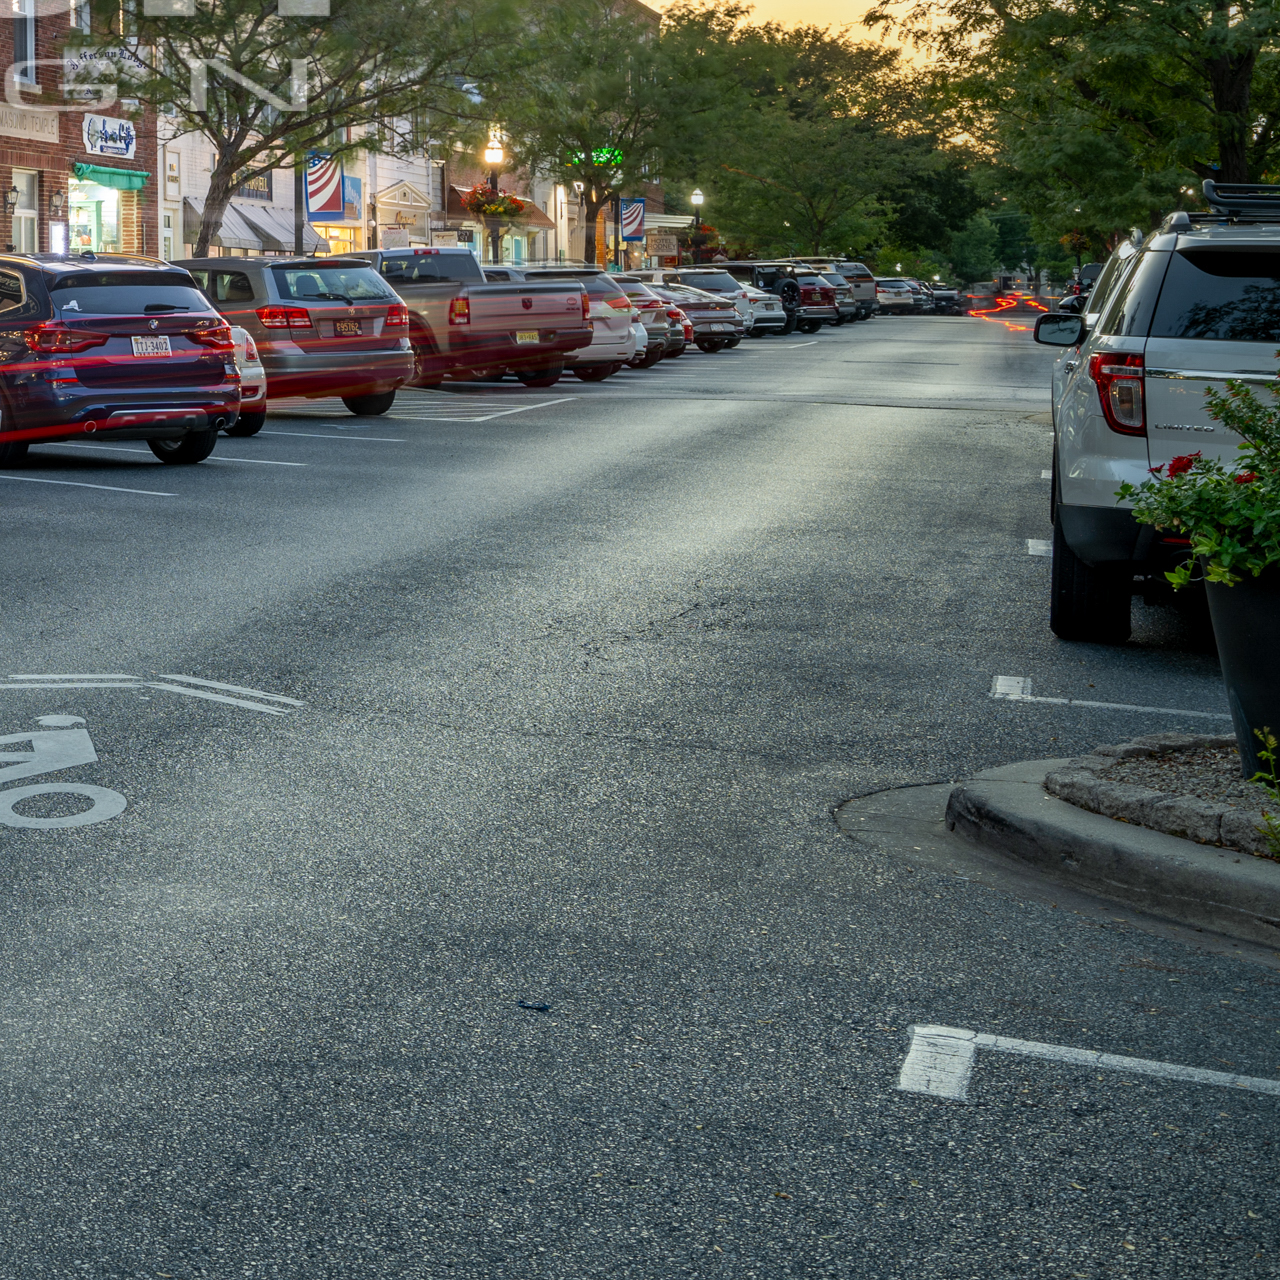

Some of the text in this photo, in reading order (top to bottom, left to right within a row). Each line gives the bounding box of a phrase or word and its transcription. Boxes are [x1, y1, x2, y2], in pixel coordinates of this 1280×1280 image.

[0, 110, 56, 135] MASONIC TEMPLE
[135, 341, 168, 351] TTJ-3402
[1154, 422, 1215, 433] LIMITED
